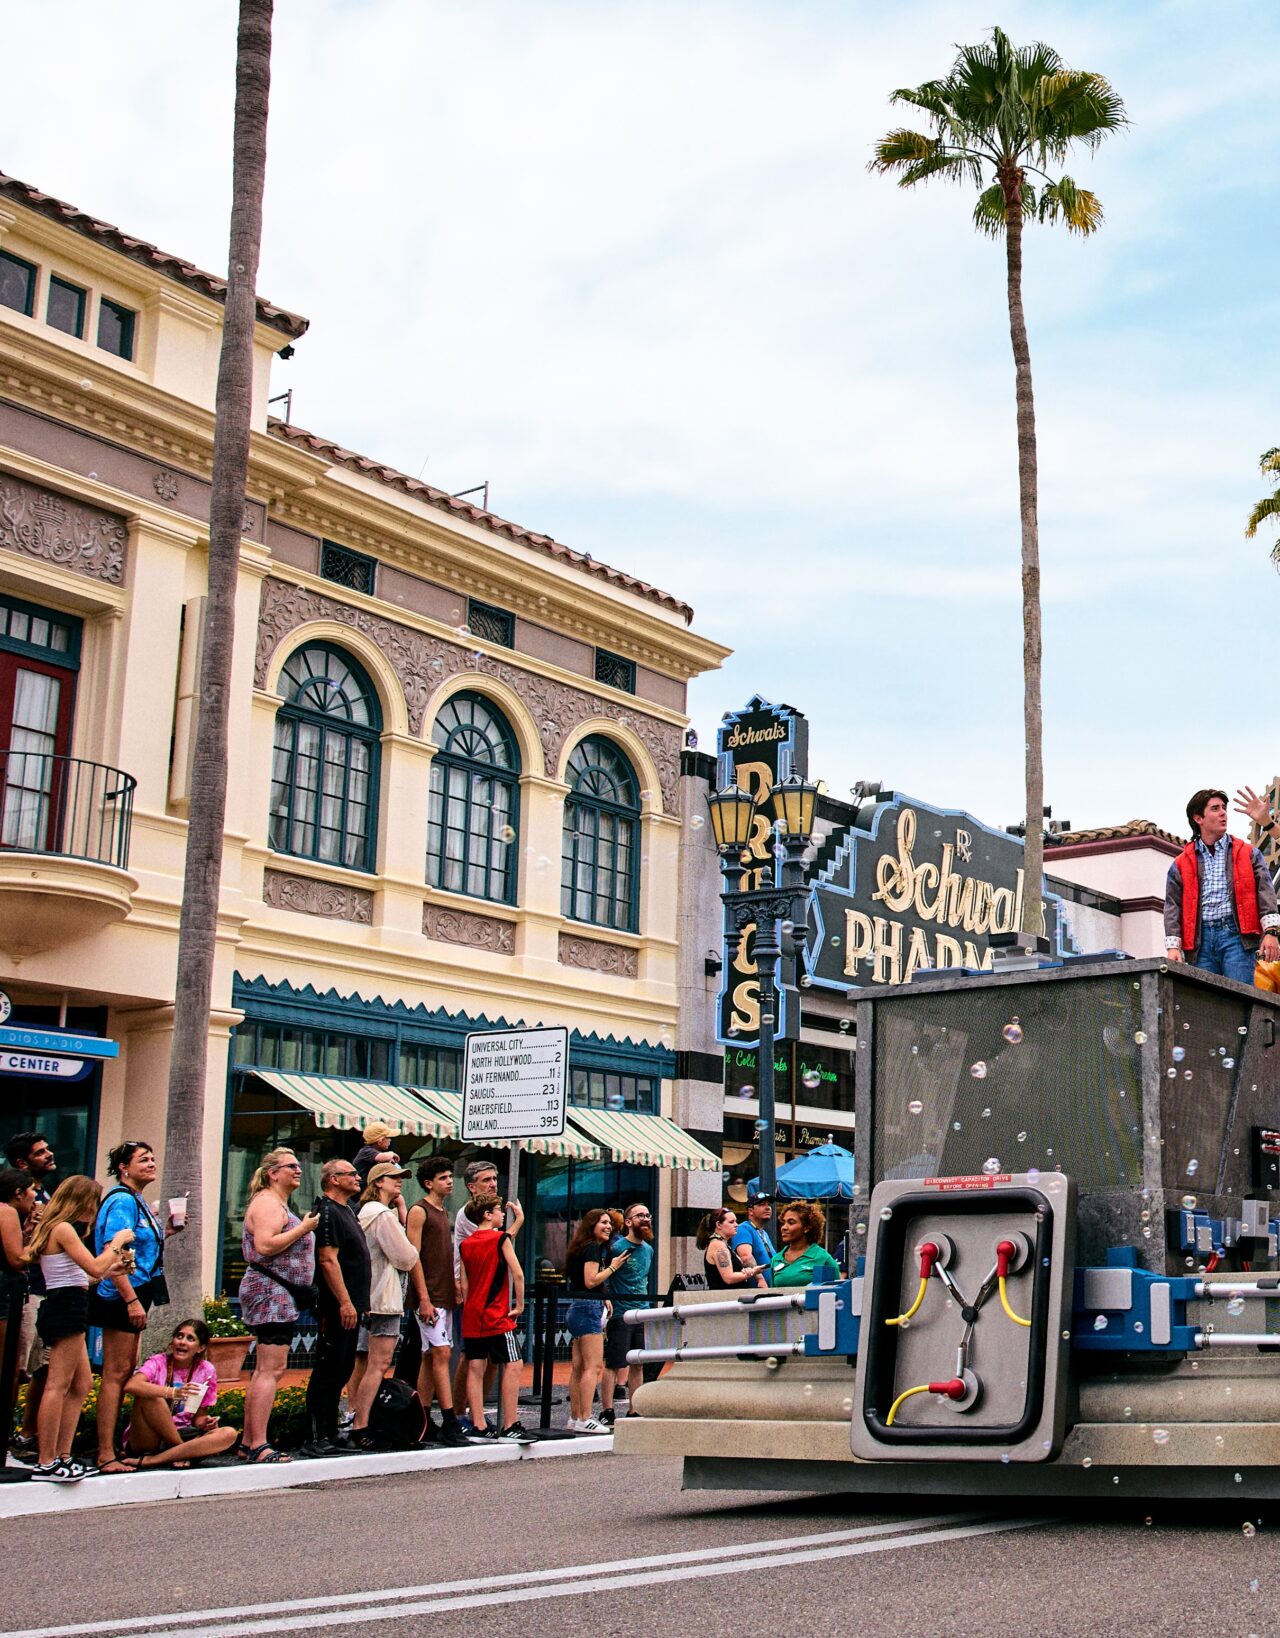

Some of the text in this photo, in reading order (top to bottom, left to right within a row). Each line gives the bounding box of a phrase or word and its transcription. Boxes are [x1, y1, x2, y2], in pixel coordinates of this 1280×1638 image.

[727, 722, 786, 747] Schwab's
[872, 808, 1049, 940] Schwa
[472, 1039, 524, 1053] UNIVERSAL CITY
[9, 1056, 60, 1073] CENTER
[471, 1052, 561, 1068] NORTH HOLLYWOOD 2
[735, 1050, 756, 1069] Cold
[470, 1074, 483, 1084] SAN
[485, 1070, 520, 1083] FERNANDO
[470, 1088, 495, 1100] SAUGUS
[469, 1100, 559, 1115] BAKERSFIELD 113
[468, 1116, 559, 1132] OAKLAND 395
